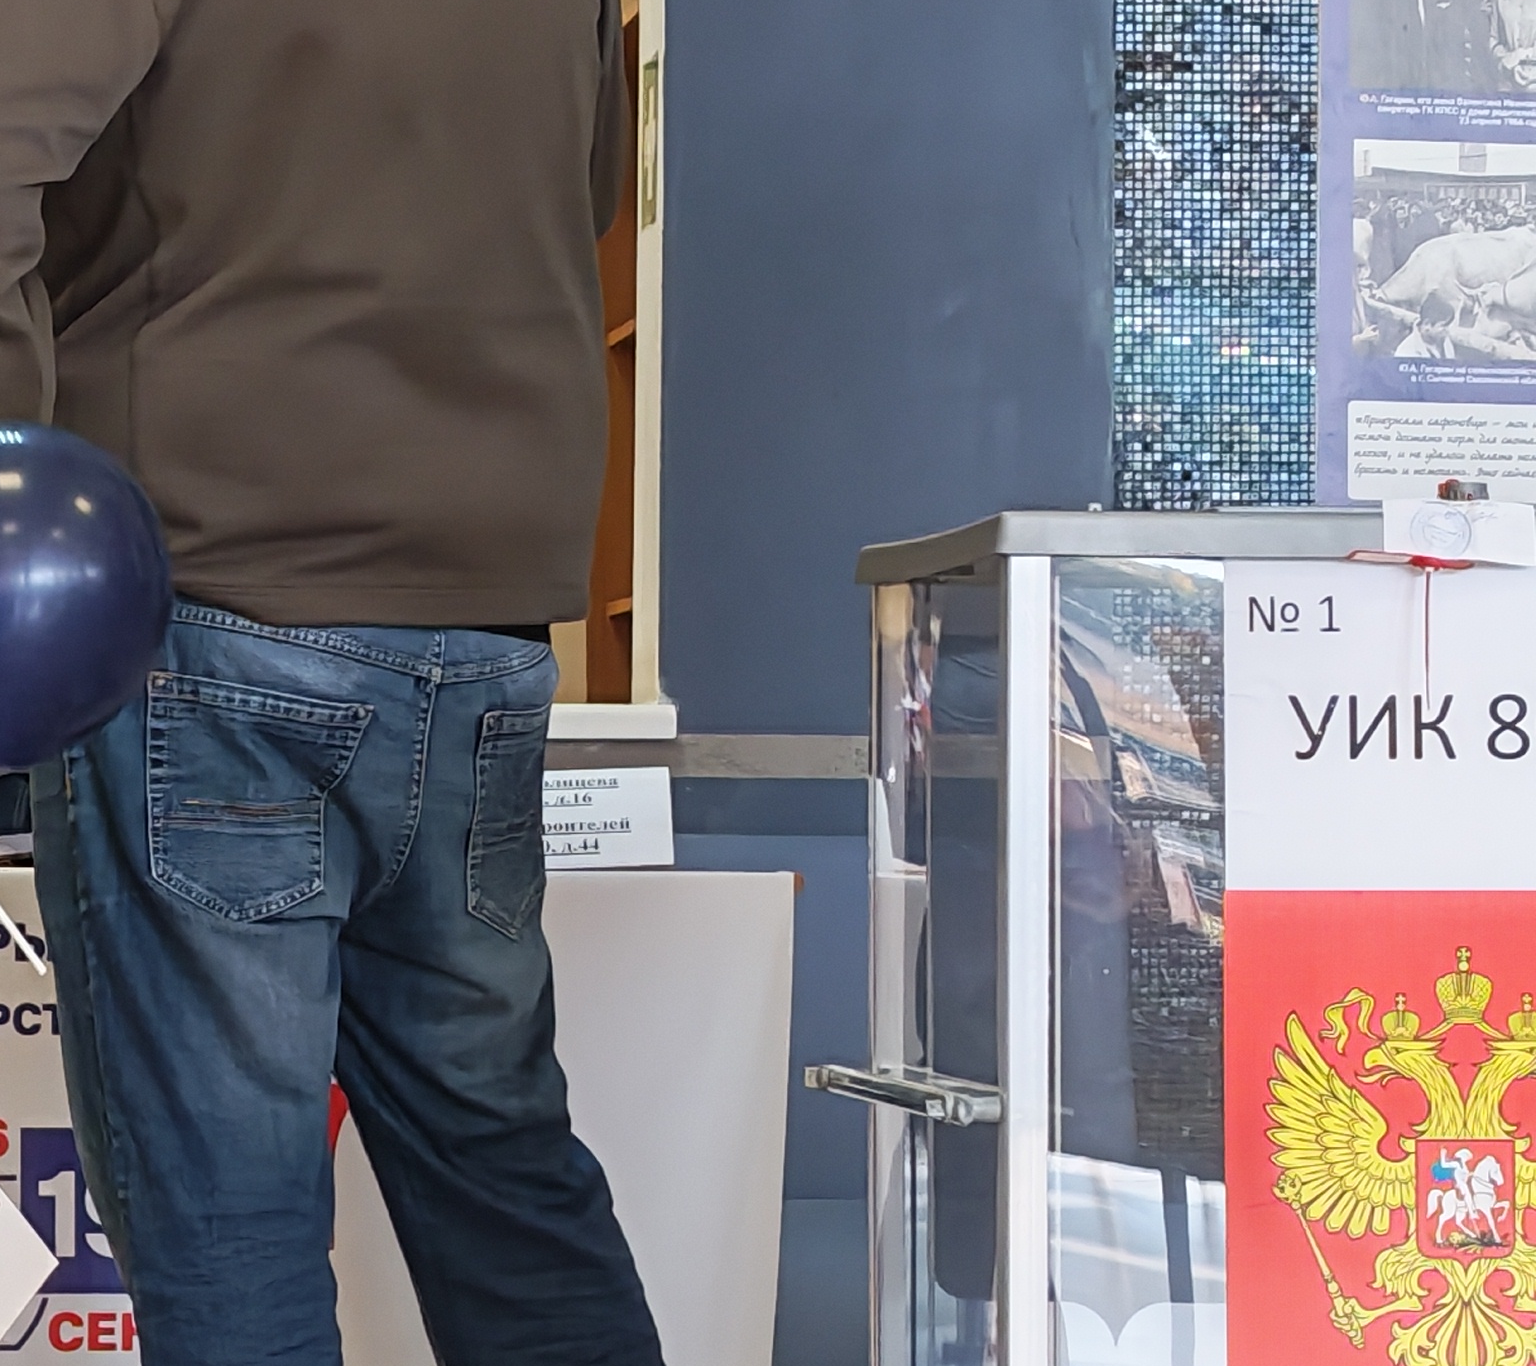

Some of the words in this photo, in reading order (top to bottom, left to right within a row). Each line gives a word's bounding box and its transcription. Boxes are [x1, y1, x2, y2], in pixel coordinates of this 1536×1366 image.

[1248, 596, 1300, 633] №
[1319, 596, 1341, 632] 1
[1287, 695, 1457, 760] УИК
[1487, 694, 1531, 760] 8
